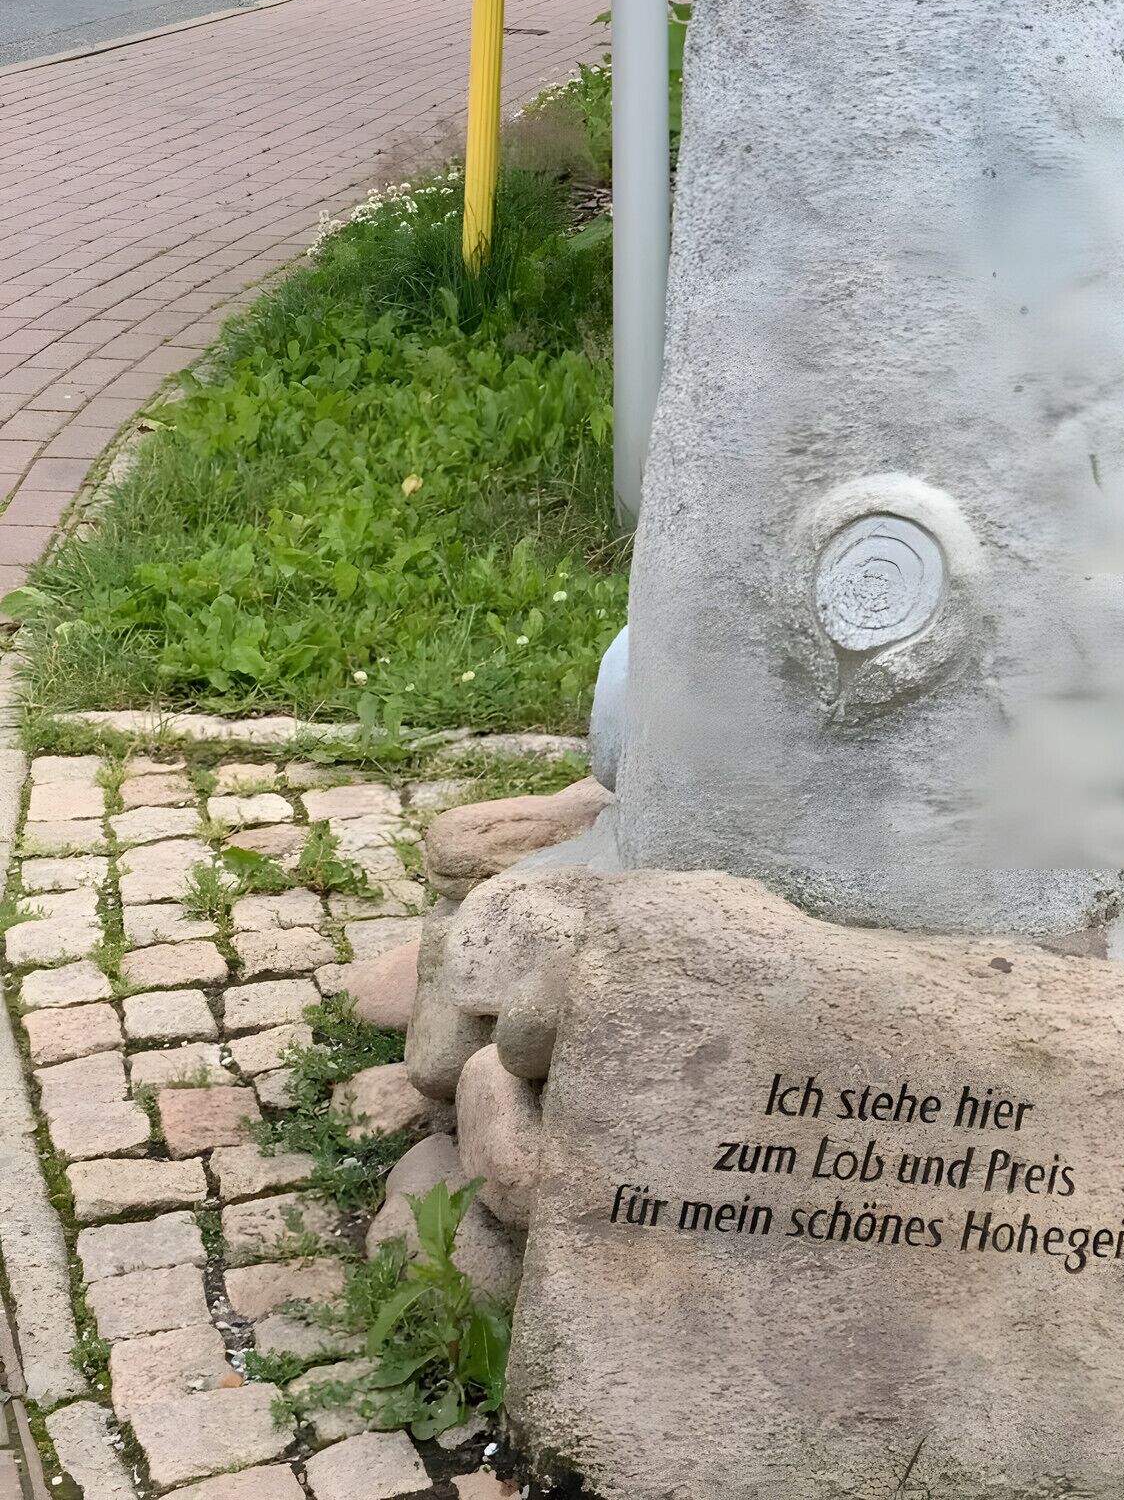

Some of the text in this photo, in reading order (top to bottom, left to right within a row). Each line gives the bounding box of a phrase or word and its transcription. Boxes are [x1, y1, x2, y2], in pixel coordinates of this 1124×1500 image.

[765, 1073, 1035, 1132] Ich stehe hier
[713, 1134, 1076, 1197] zum Lob und Preis
[610, 1183, 668, 1227] für
[678, 1194, 773, 1235] mein
[785, 1197, 944, 1248] schönes
